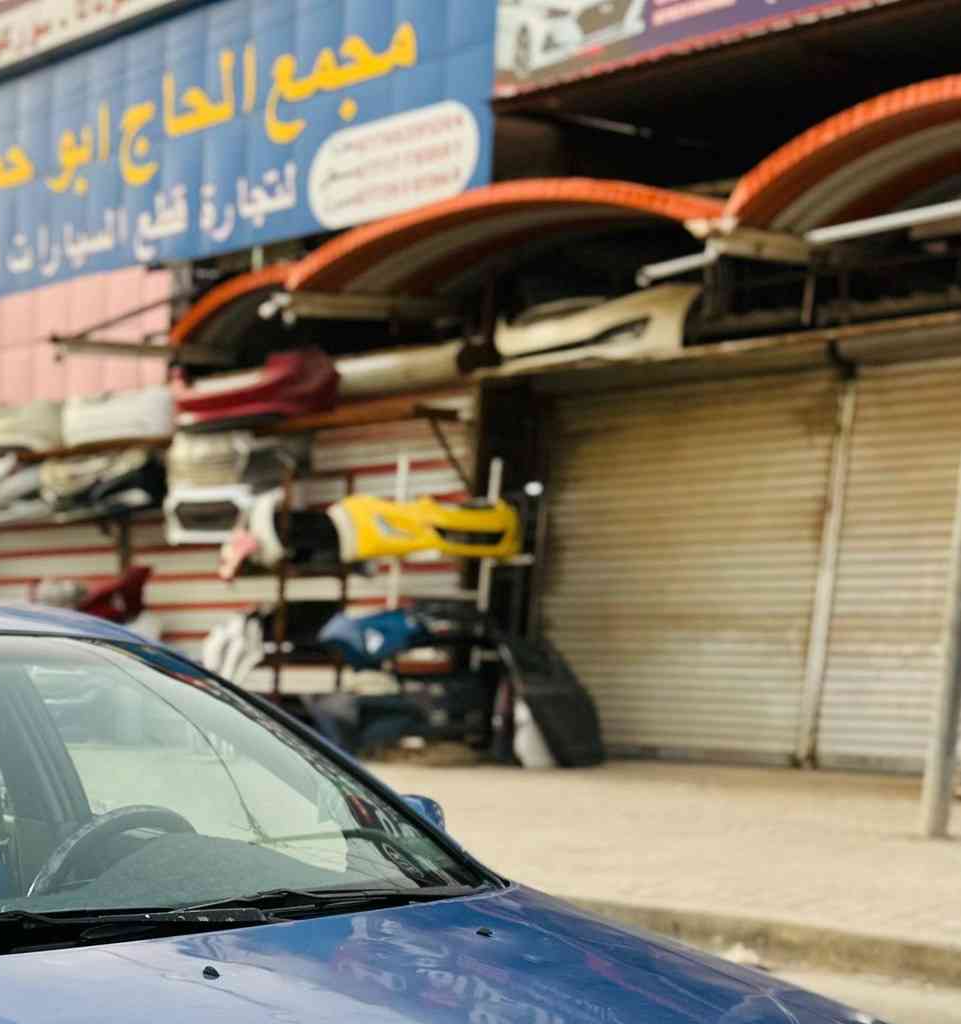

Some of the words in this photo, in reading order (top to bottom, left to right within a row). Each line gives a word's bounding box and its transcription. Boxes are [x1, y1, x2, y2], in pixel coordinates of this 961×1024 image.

[120, 37, 256, 186] الحاج
[265, 22, 417, 144] مجمع
[46, 101, 109, 195] ابو
[7, 208, 128, 277] السيارات
[134, 183, 188, 262] قطع
[200, 160, 297, 242] لتجارة
